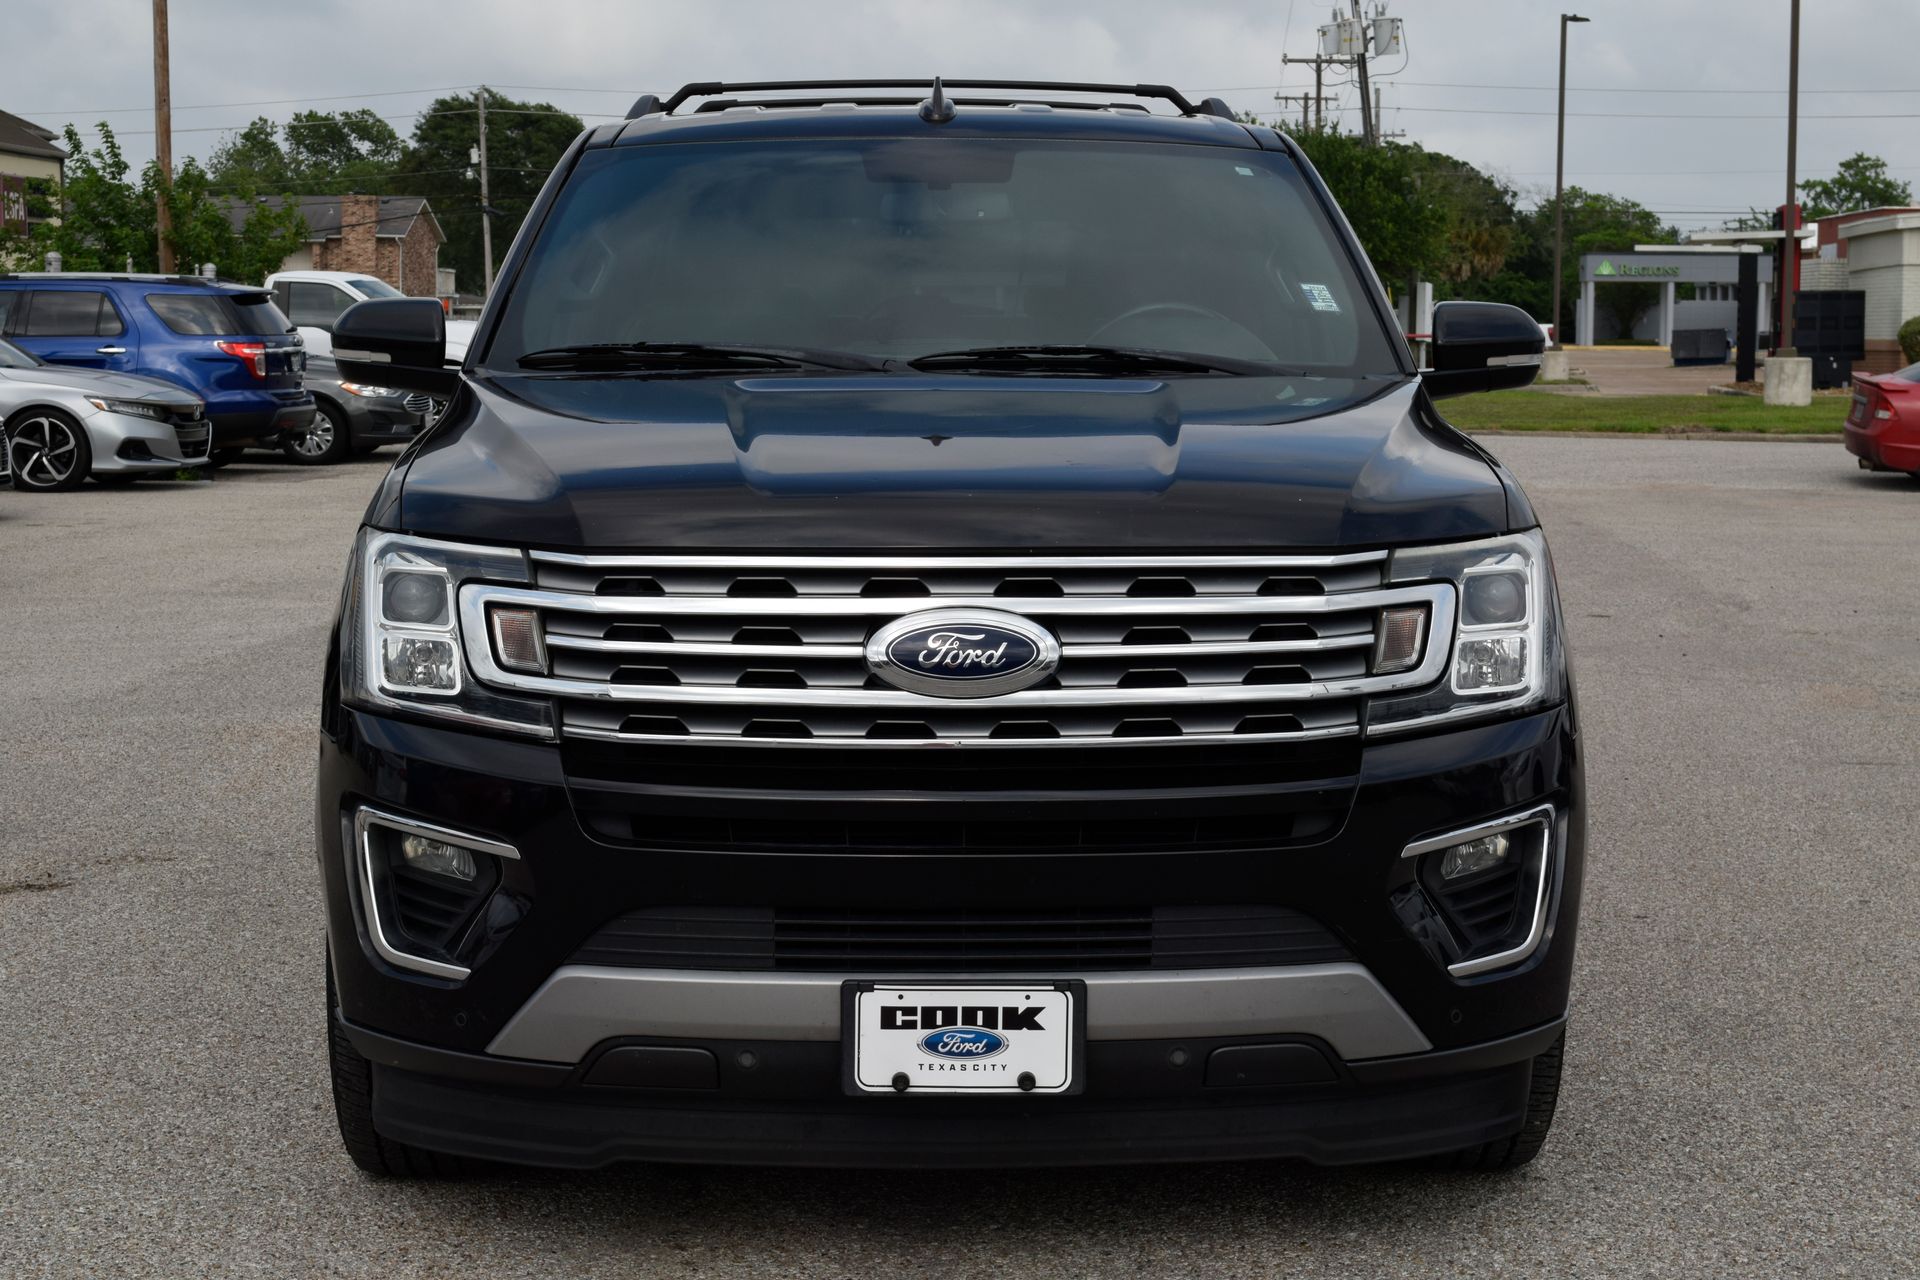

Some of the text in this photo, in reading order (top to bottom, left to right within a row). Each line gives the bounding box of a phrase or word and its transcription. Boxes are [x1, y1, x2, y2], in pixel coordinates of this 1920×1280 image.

[918, 632, 1008, 669] Ford
[880, 1005, 1046, 1031] COOK
[937, 1032, 987, 1053] Ford
[918, 1063, 1008, 1072] TEXAS CITY
